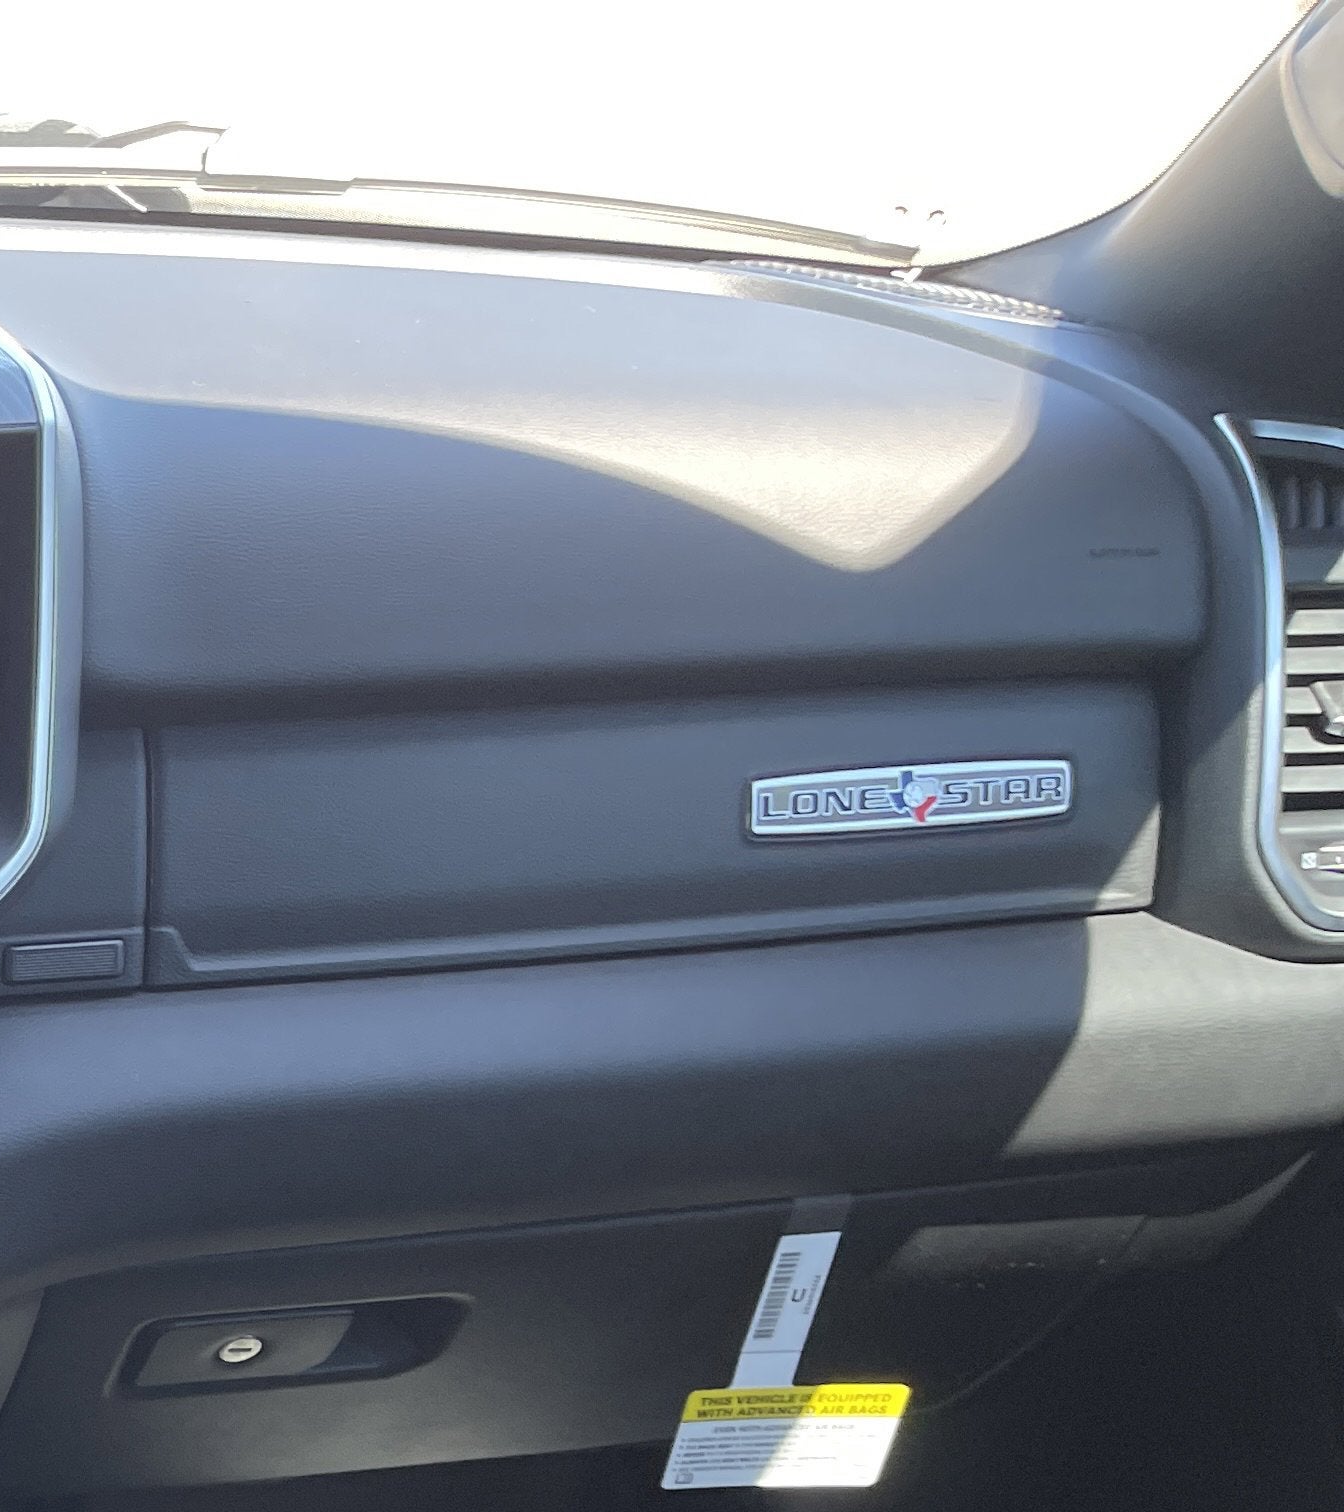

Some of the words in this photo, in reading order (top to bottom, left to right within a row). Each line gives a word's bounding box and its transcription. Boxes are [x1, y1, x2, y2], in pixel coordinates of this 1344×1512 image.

[757, 787, 890, 820] LONE
[940, 773, 1066, 807] STAR
[701, 1396, 732, 1407] THIS
[737, 1393, 795, 1405] VEHICLE
[817, 1392, 893, 1404] EQUIPPED
[696, 1408, 734, 1419] WITH
[736, 1406, 816, 1417] ADVANCED
[848, 1405, 889, 1415] BAGS
